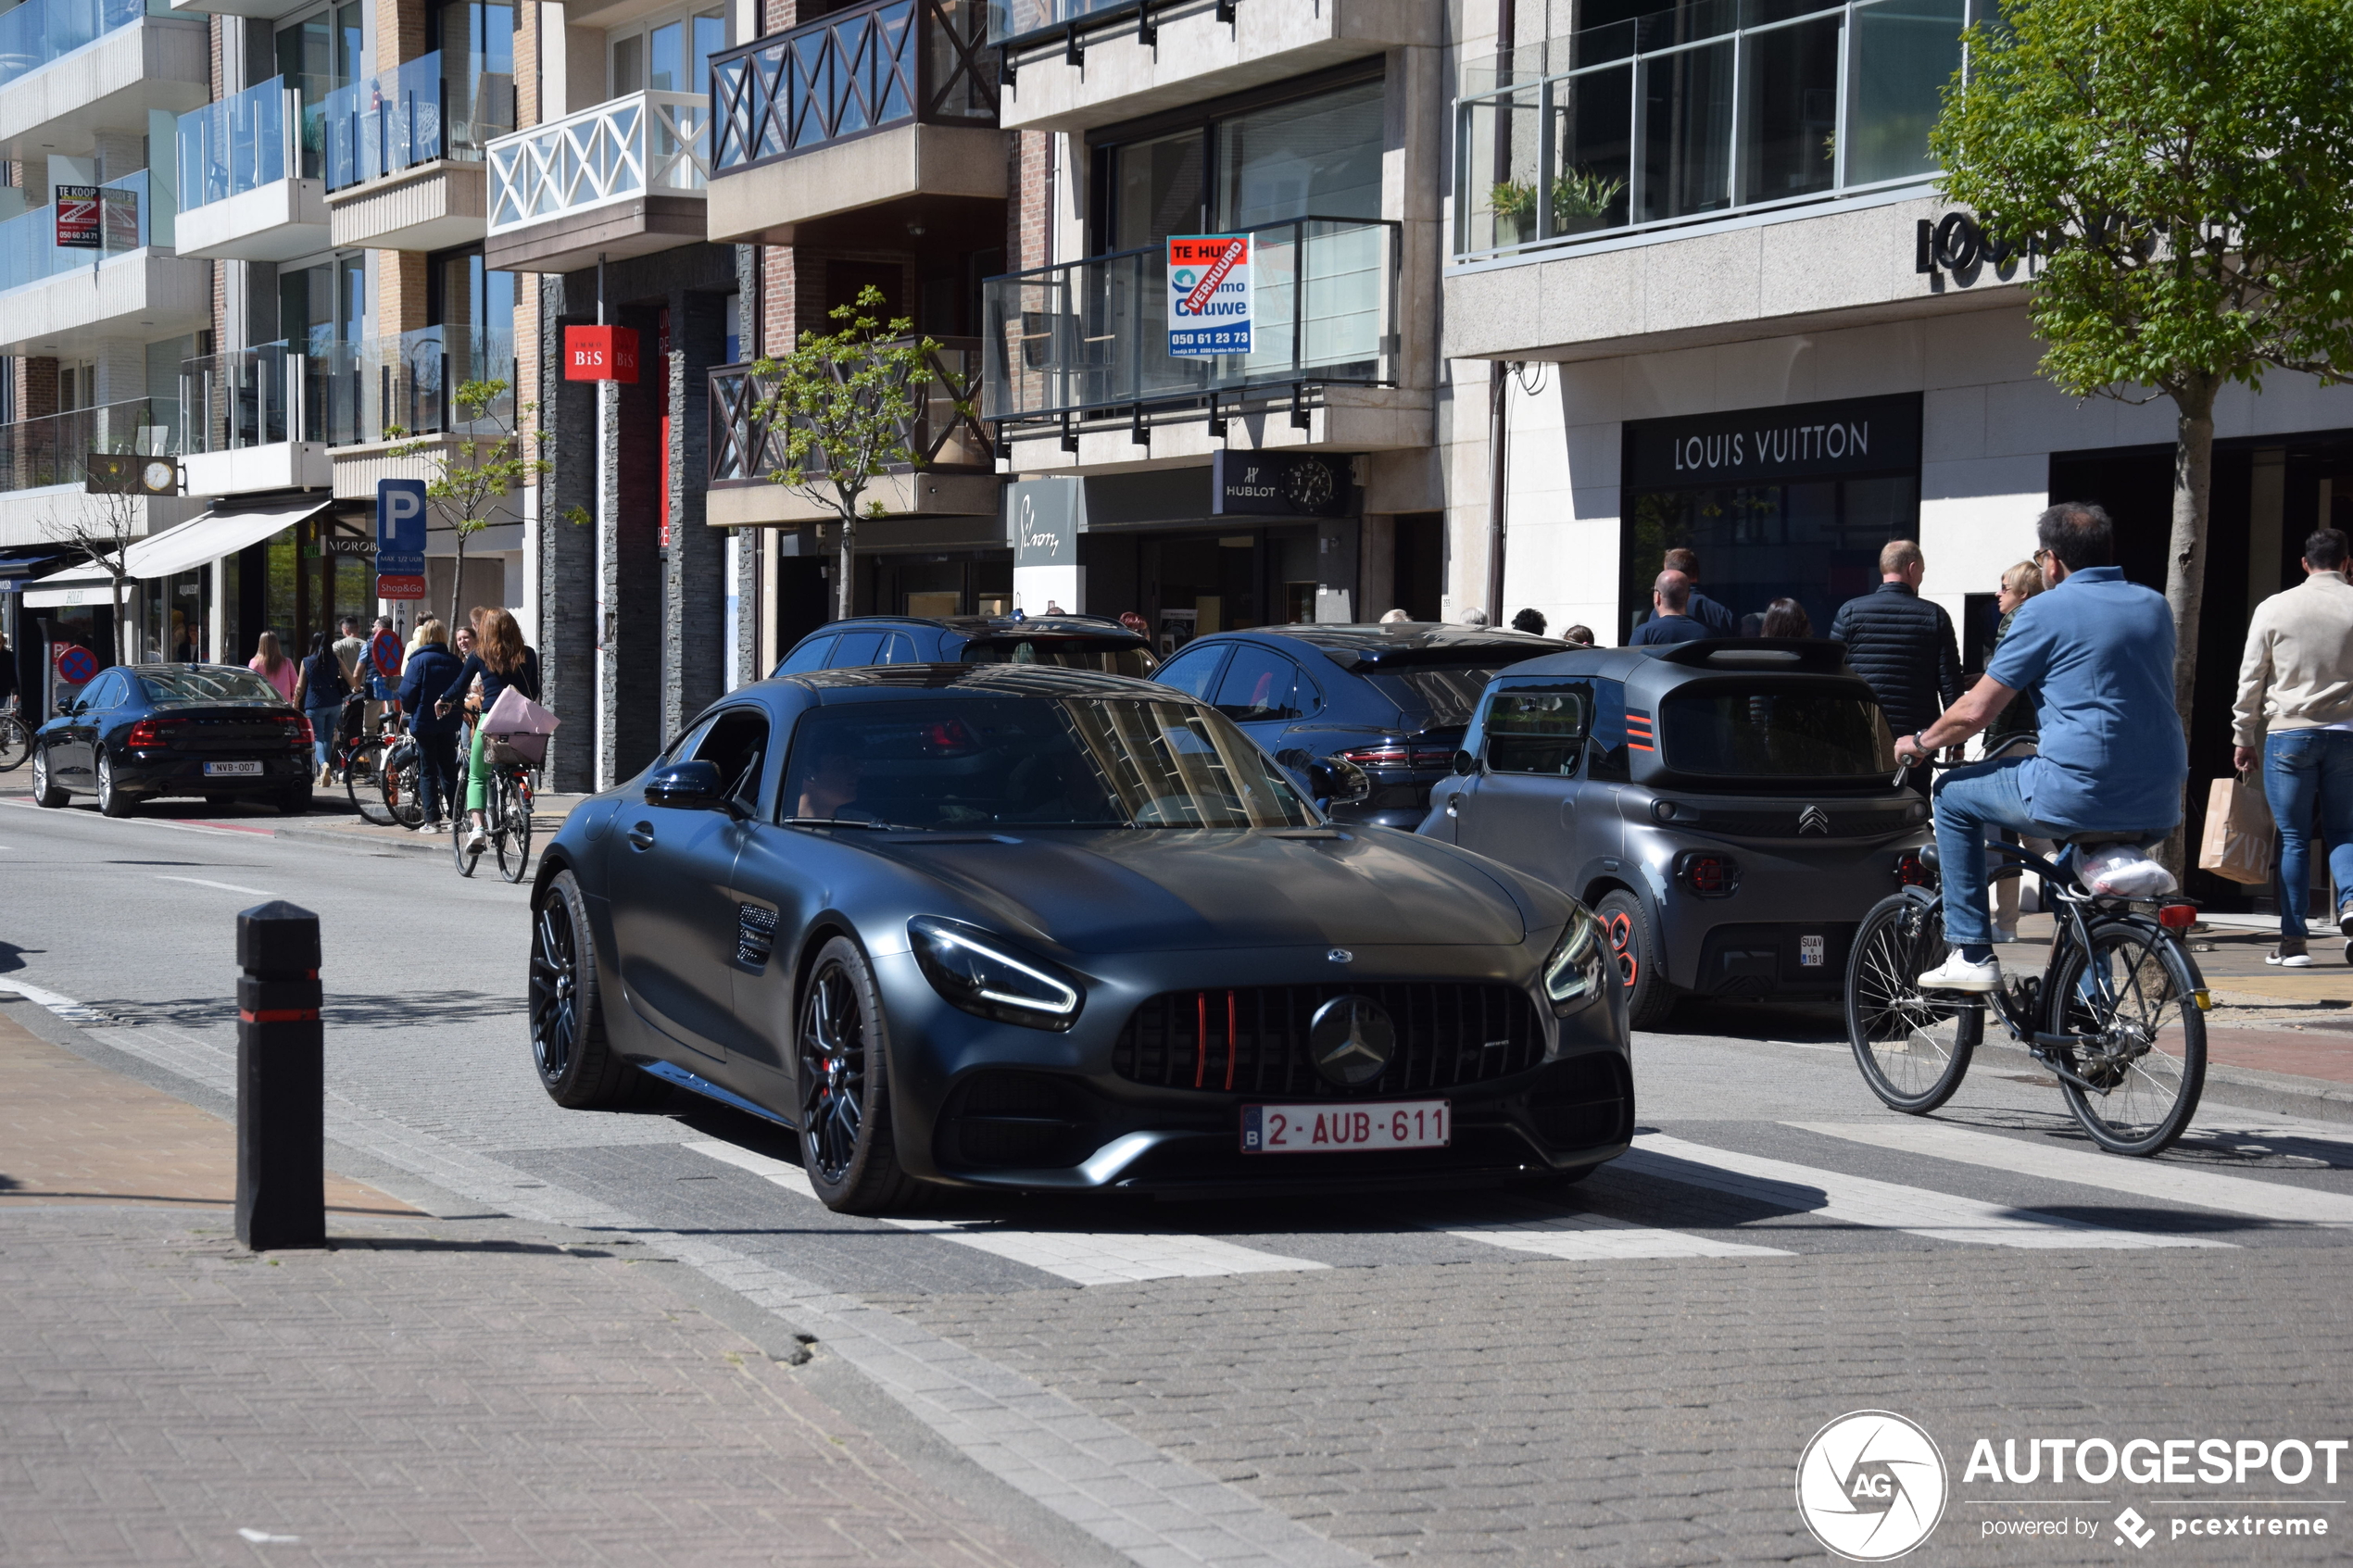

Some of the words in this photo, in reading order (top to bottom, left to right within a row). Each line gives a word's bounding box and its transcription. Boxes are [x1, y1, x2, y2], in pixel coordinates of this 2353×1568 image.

[59, 187, 69, 196] TE
[71, 187, 96, 197] KOOP
[64, 203, 92, 220] MELKERT
[1174, 246, 1192, 258] TE
[1188, 241, 1242, 310] VERHUURD
[1172, 334, 1194, 345] 050
[1197, 334, 1211, 344] 61
[1215, 333, 1230, 344] 23
[1234, 332, 1248, 343] 73
[575, 351, 603, 365] BiS
[617, 352, 634, 368] BiS
[1675, 433, 1743, 470] LOUIS
[1755, 421, 1868, 464] VUITTON
[1227, 486, 1275, 497] HUBLOT
[386, 490, 419, 539] P
[329, 540, 381, 552] MOROB
[381, 584, 422, 593] Shop&Go
[216, 763, 255, 771] NVB-007
[1802, 938, 1822, 947] SUAV
[1808, 954, 1822, 963] 181
[1246, 1131, 1258, 1145] B
